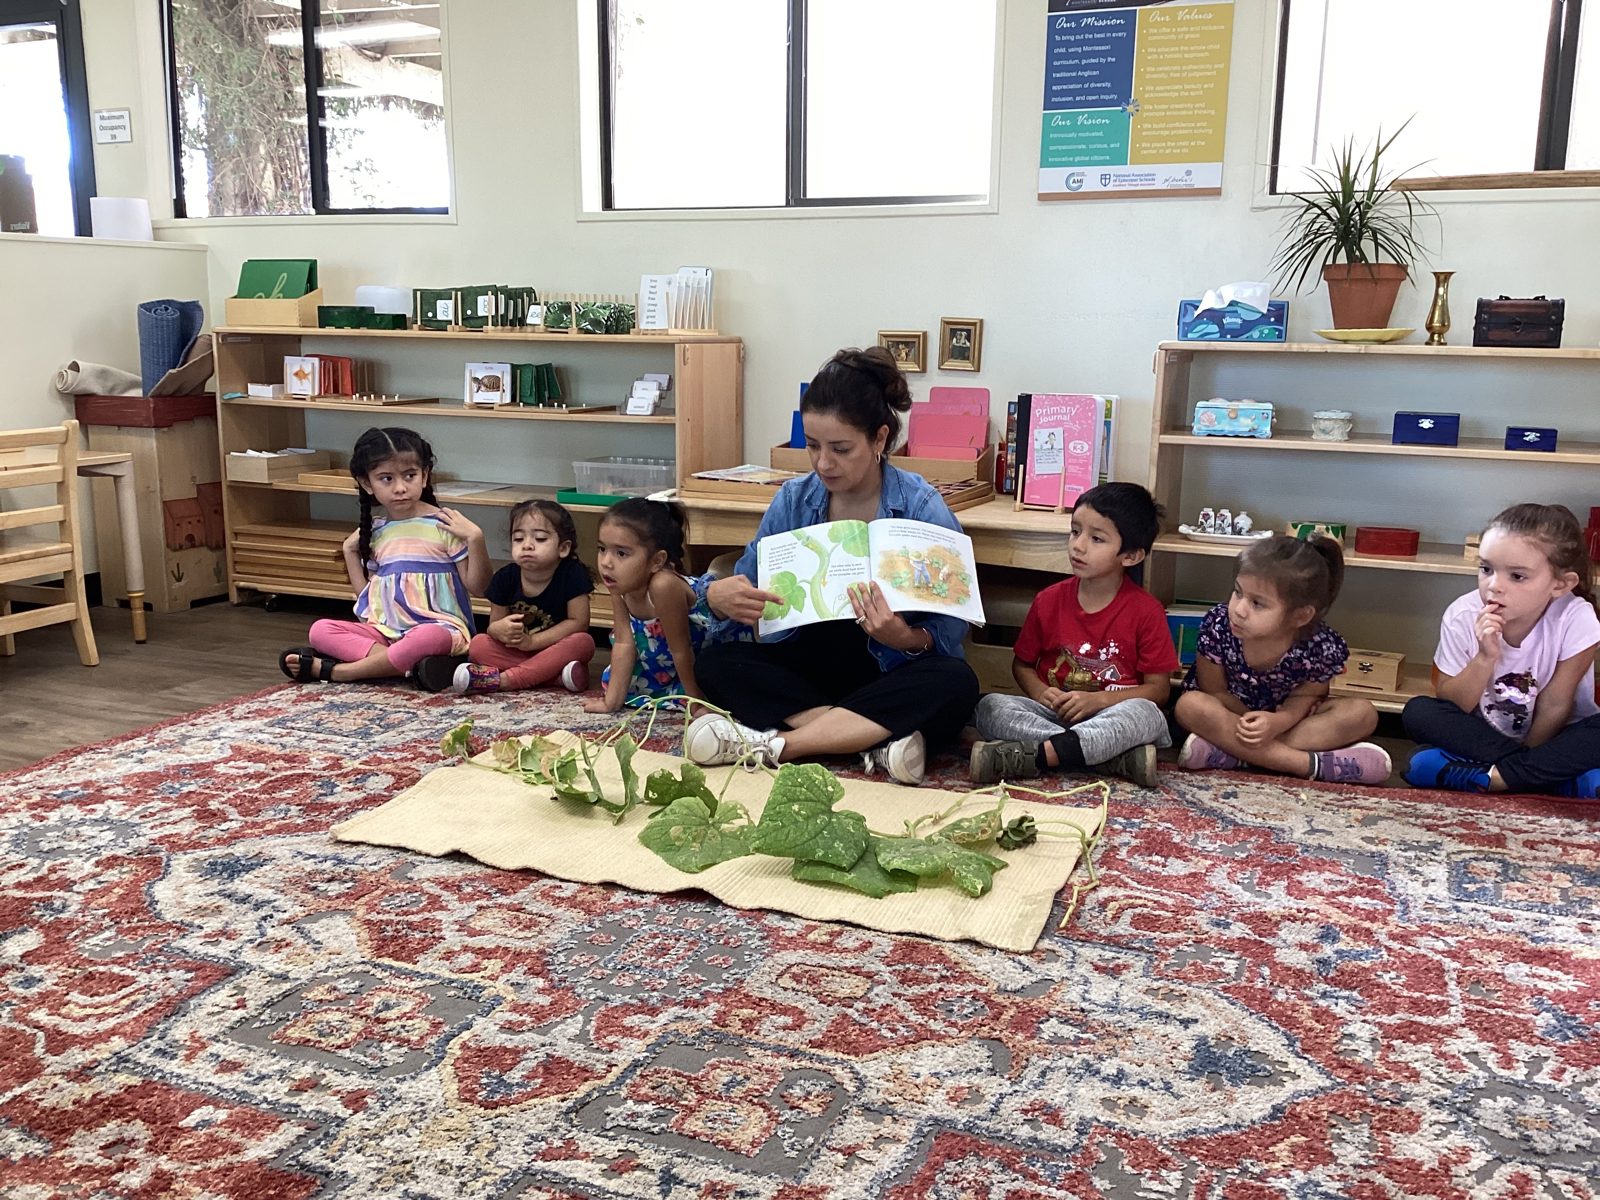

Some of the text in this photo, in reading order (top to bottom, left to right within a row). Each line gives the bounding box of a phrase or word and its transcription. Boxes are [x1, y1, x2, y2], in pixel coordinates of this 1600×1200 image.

[1150, 9, 1214, 22] Our Values
[1056, 16, 1125, 29] Our Mission
[1051, 114, 1110, 126] Our Vision
[1036, 405, 1077, 417] Primary
[1039, 413, 1070, 424] Journal
